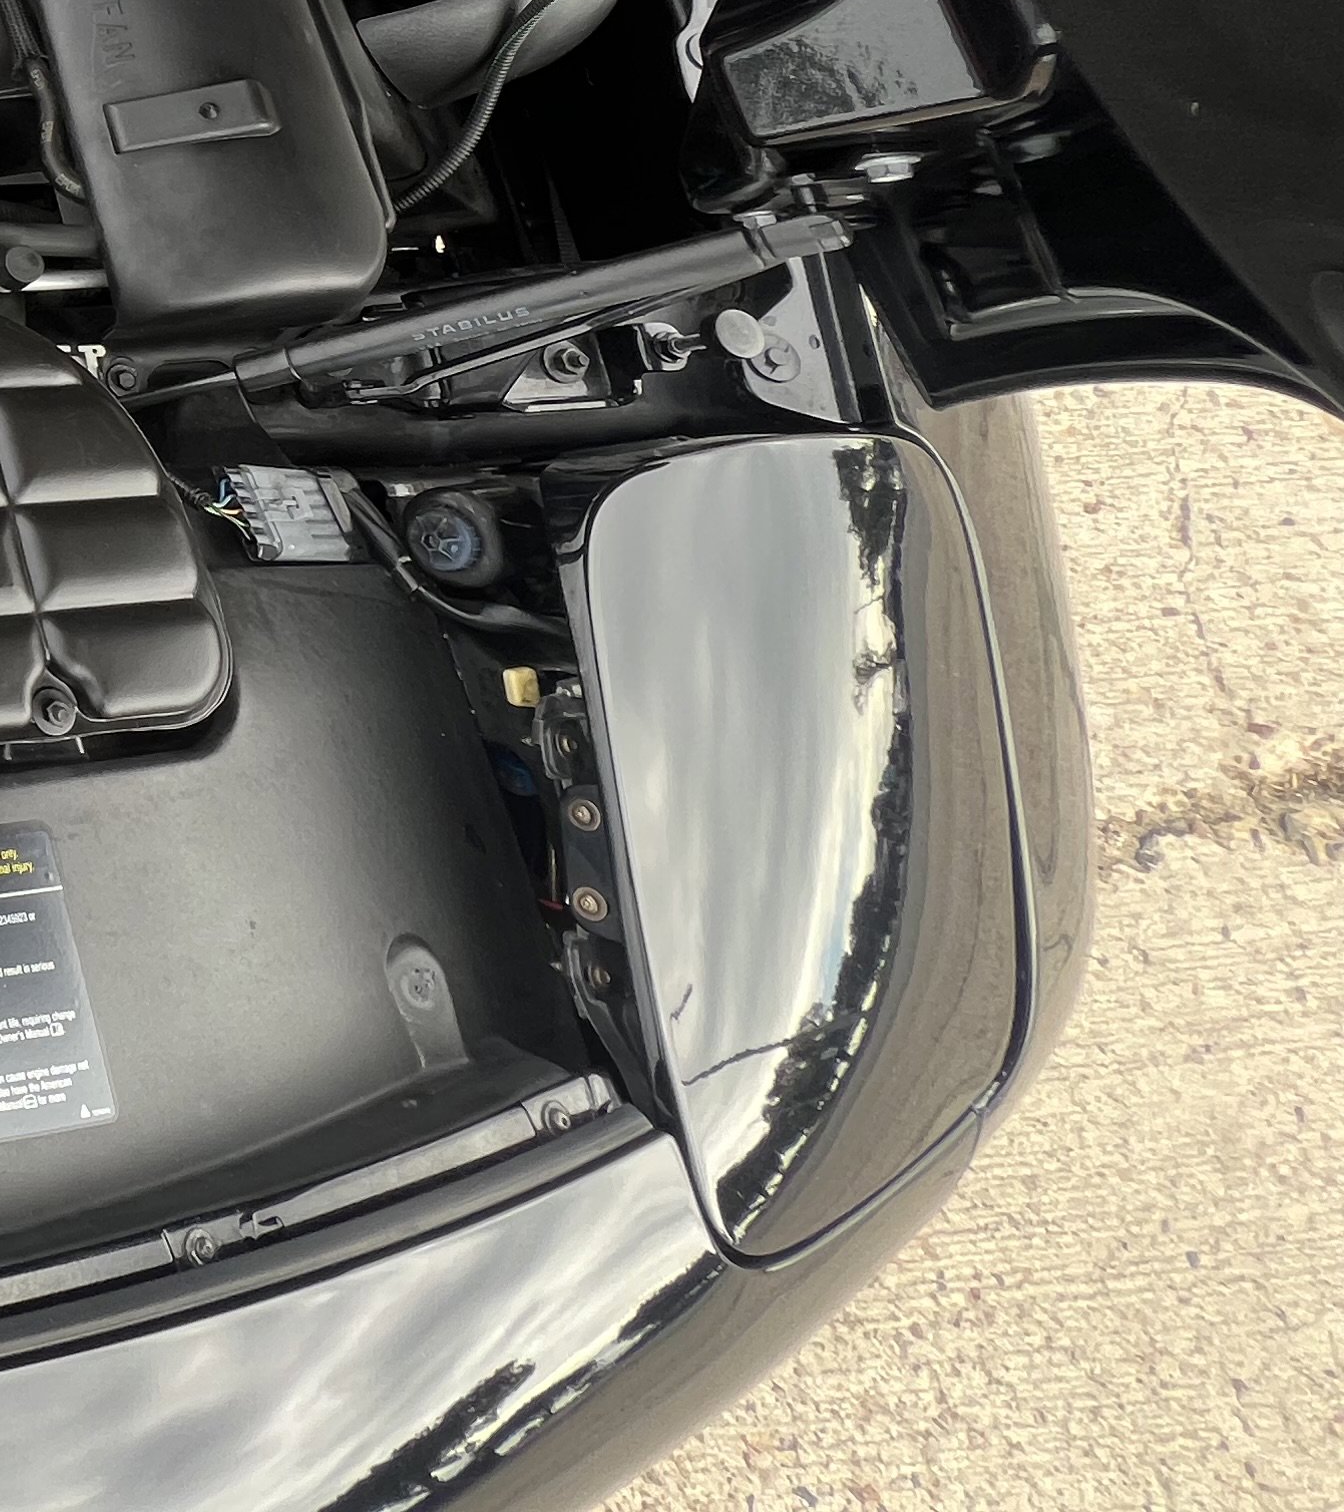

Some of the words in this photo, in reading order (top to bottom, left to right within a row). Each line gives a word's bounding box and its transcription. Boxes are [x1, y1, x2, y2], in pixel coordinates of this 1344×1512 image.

[93, 0, 135, 67] FAN
[412, 306, 530, 341] STABILUS
[0, 849, 18, 860] only.
